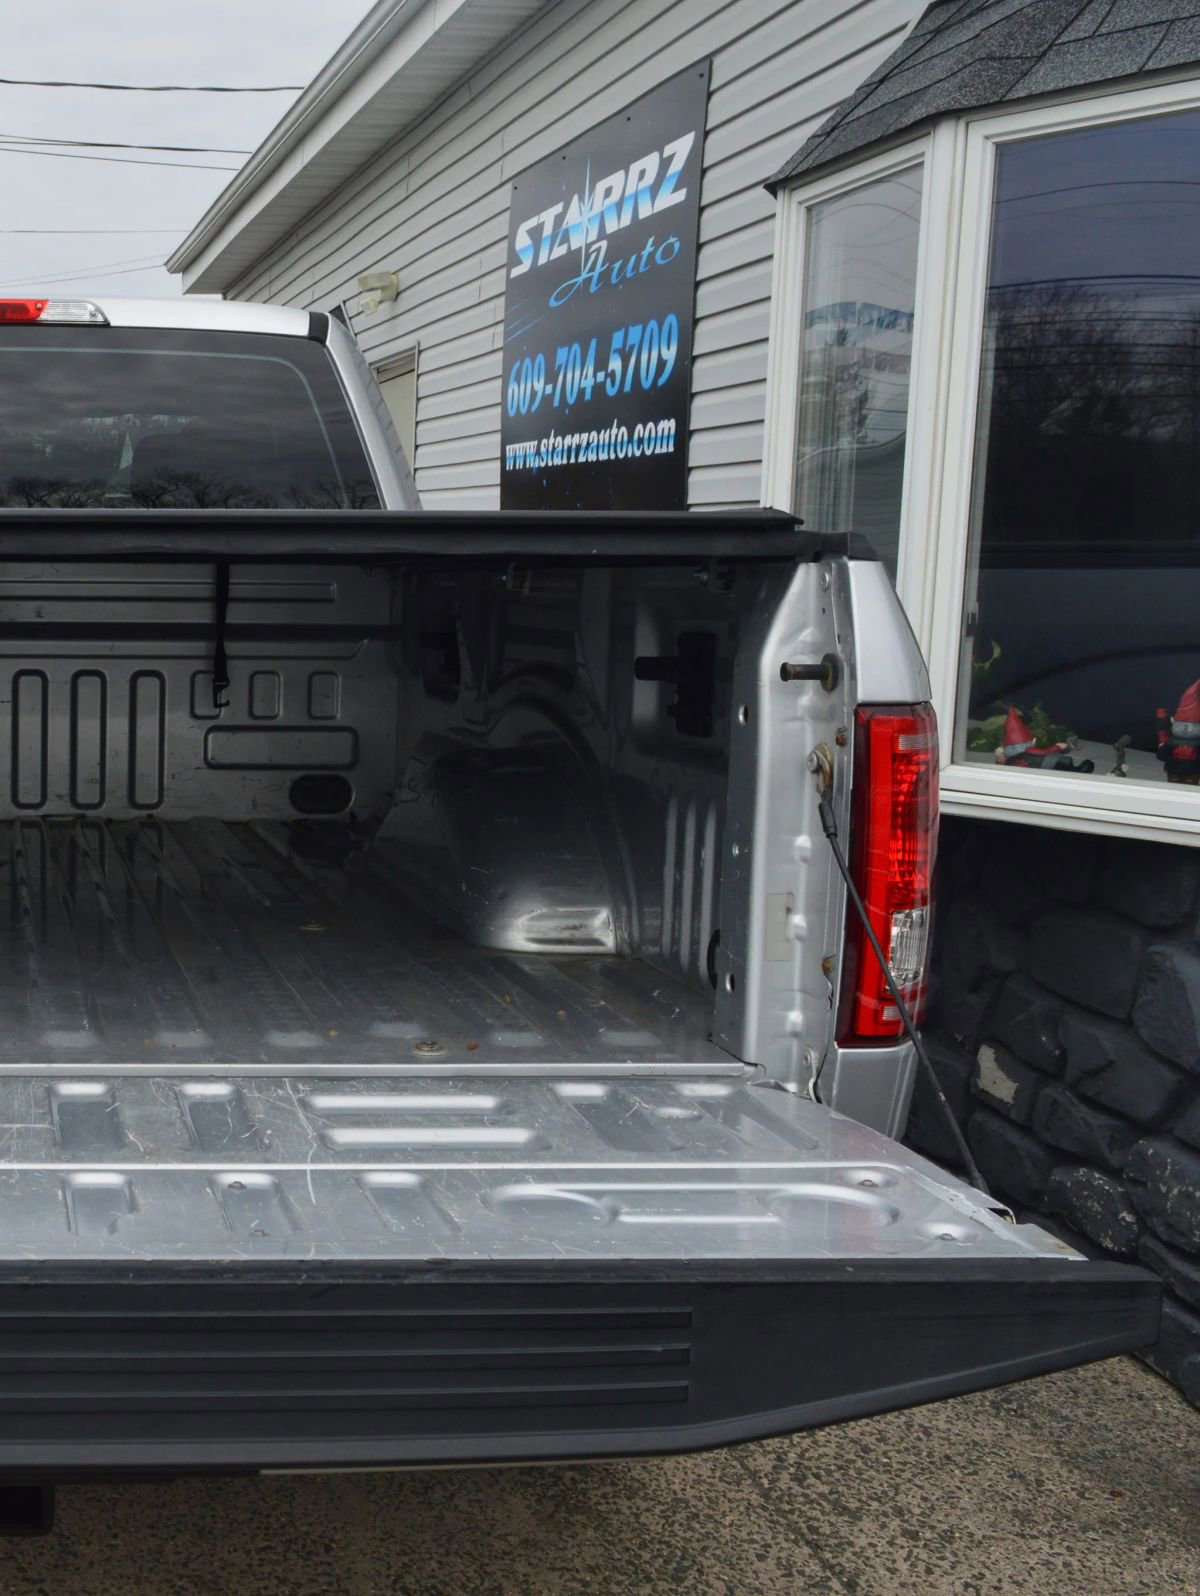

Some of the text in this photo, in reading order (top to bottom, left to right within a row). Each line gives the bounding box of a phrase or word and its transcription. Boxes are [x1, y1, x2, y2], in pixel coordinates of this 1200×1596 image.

[510, 130, 696, 279] STARRZ
[548, 235, 681, 308] Auto
[507, 313, 679, 417] 609-704-5709
[505, 418, 677, 471] www.starrzauto.com
